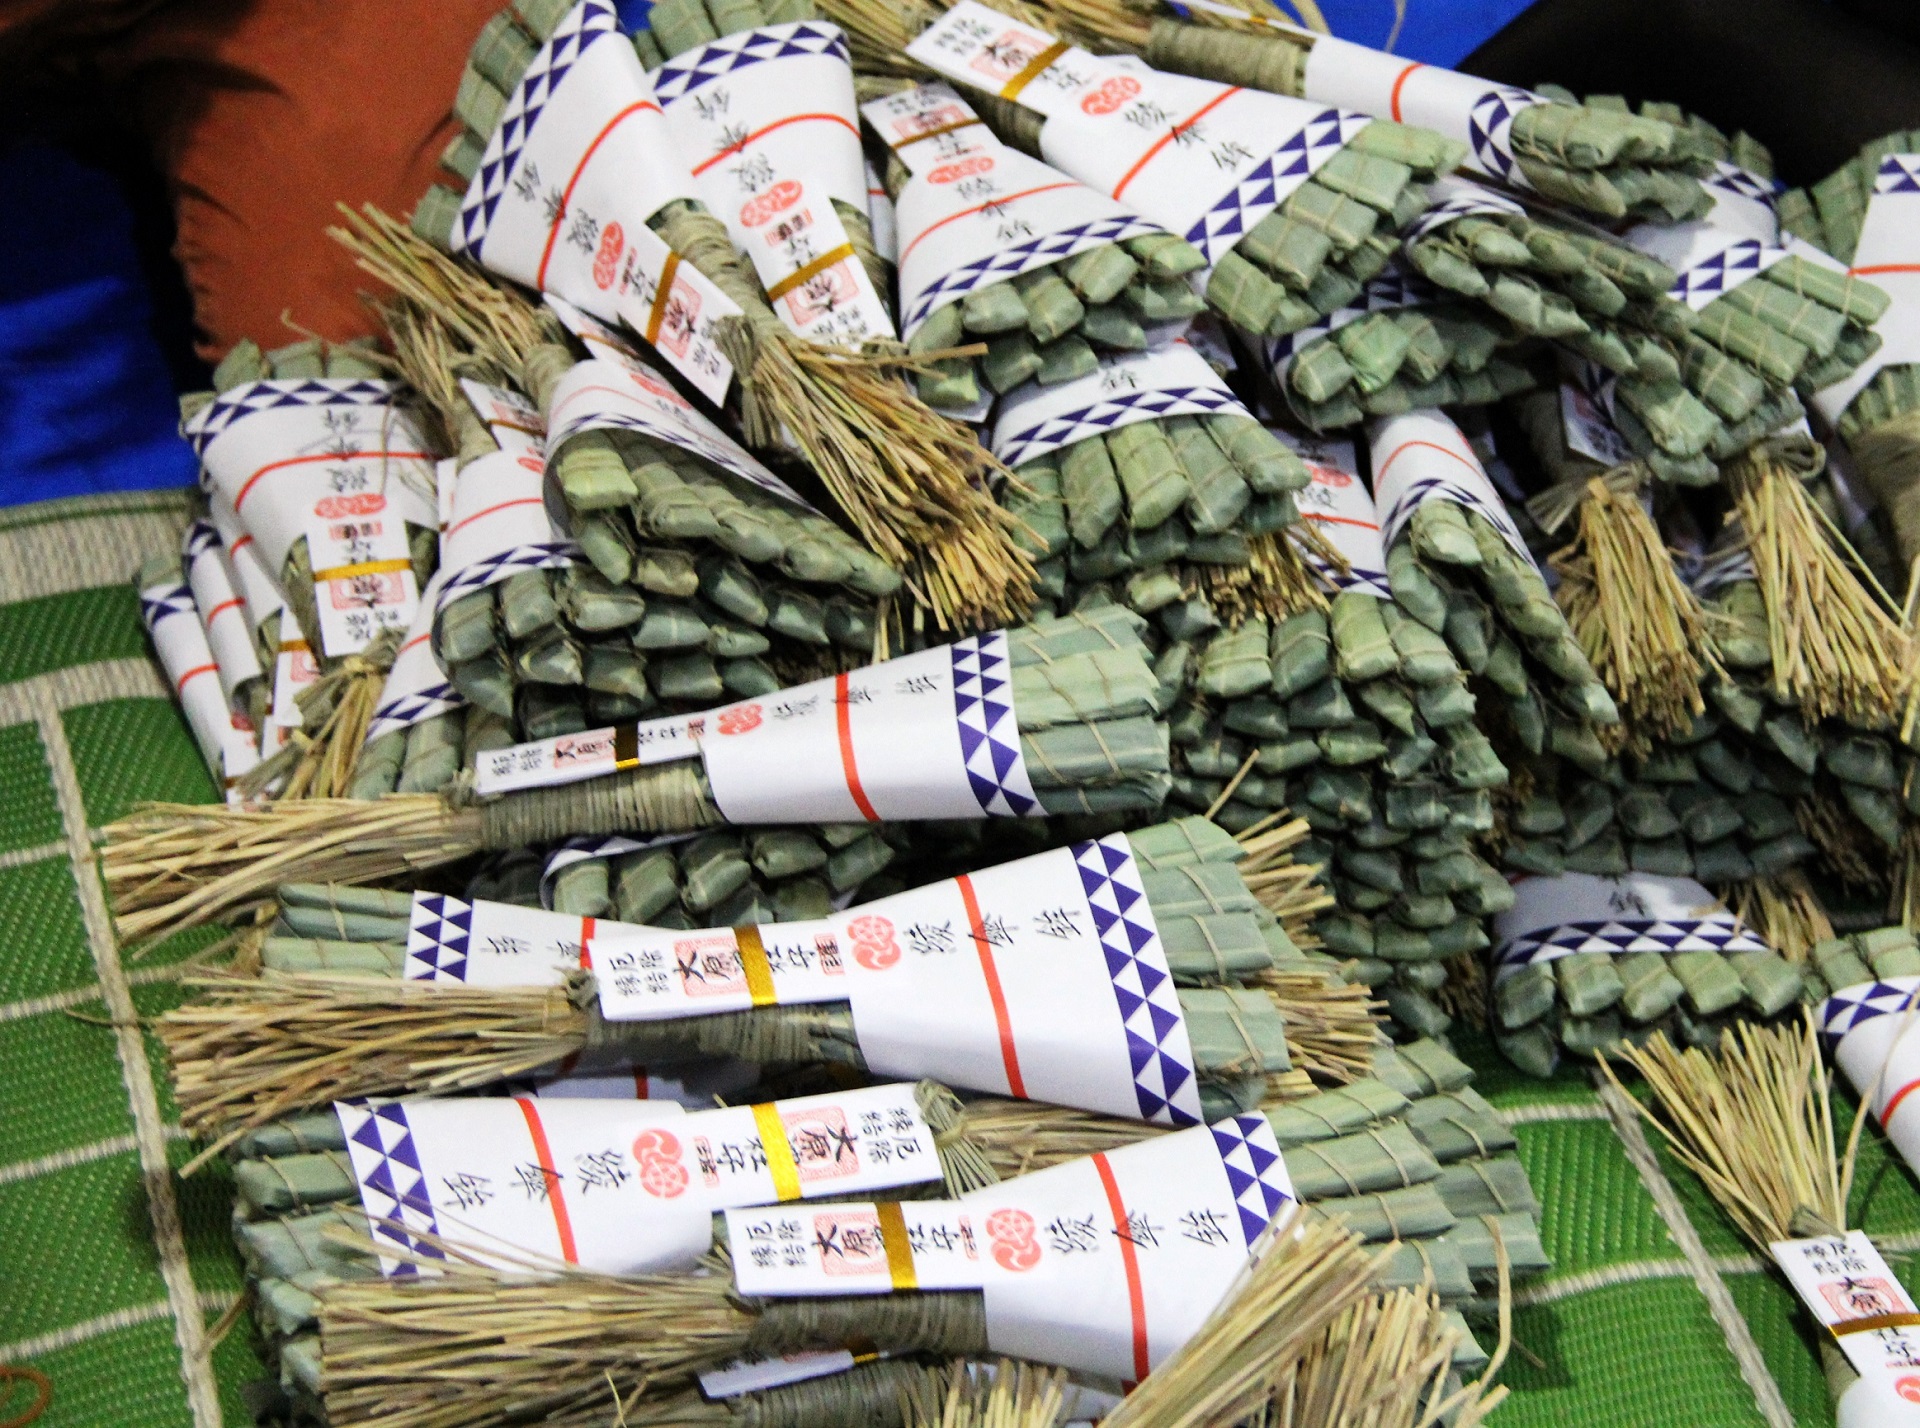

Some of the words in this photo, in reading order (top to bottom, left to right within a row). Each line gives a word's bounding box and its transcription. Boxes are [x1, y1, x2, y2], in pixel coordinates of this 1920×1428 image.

[1124, 101, 1256, 171] 綾傘鉾
[904, 906, 1081, 954] 綾傘鉾
[443, 1149, 631, 1211] 綾傘鉾
[1044, 1207, 1230, 1253] 綾傘鉾
